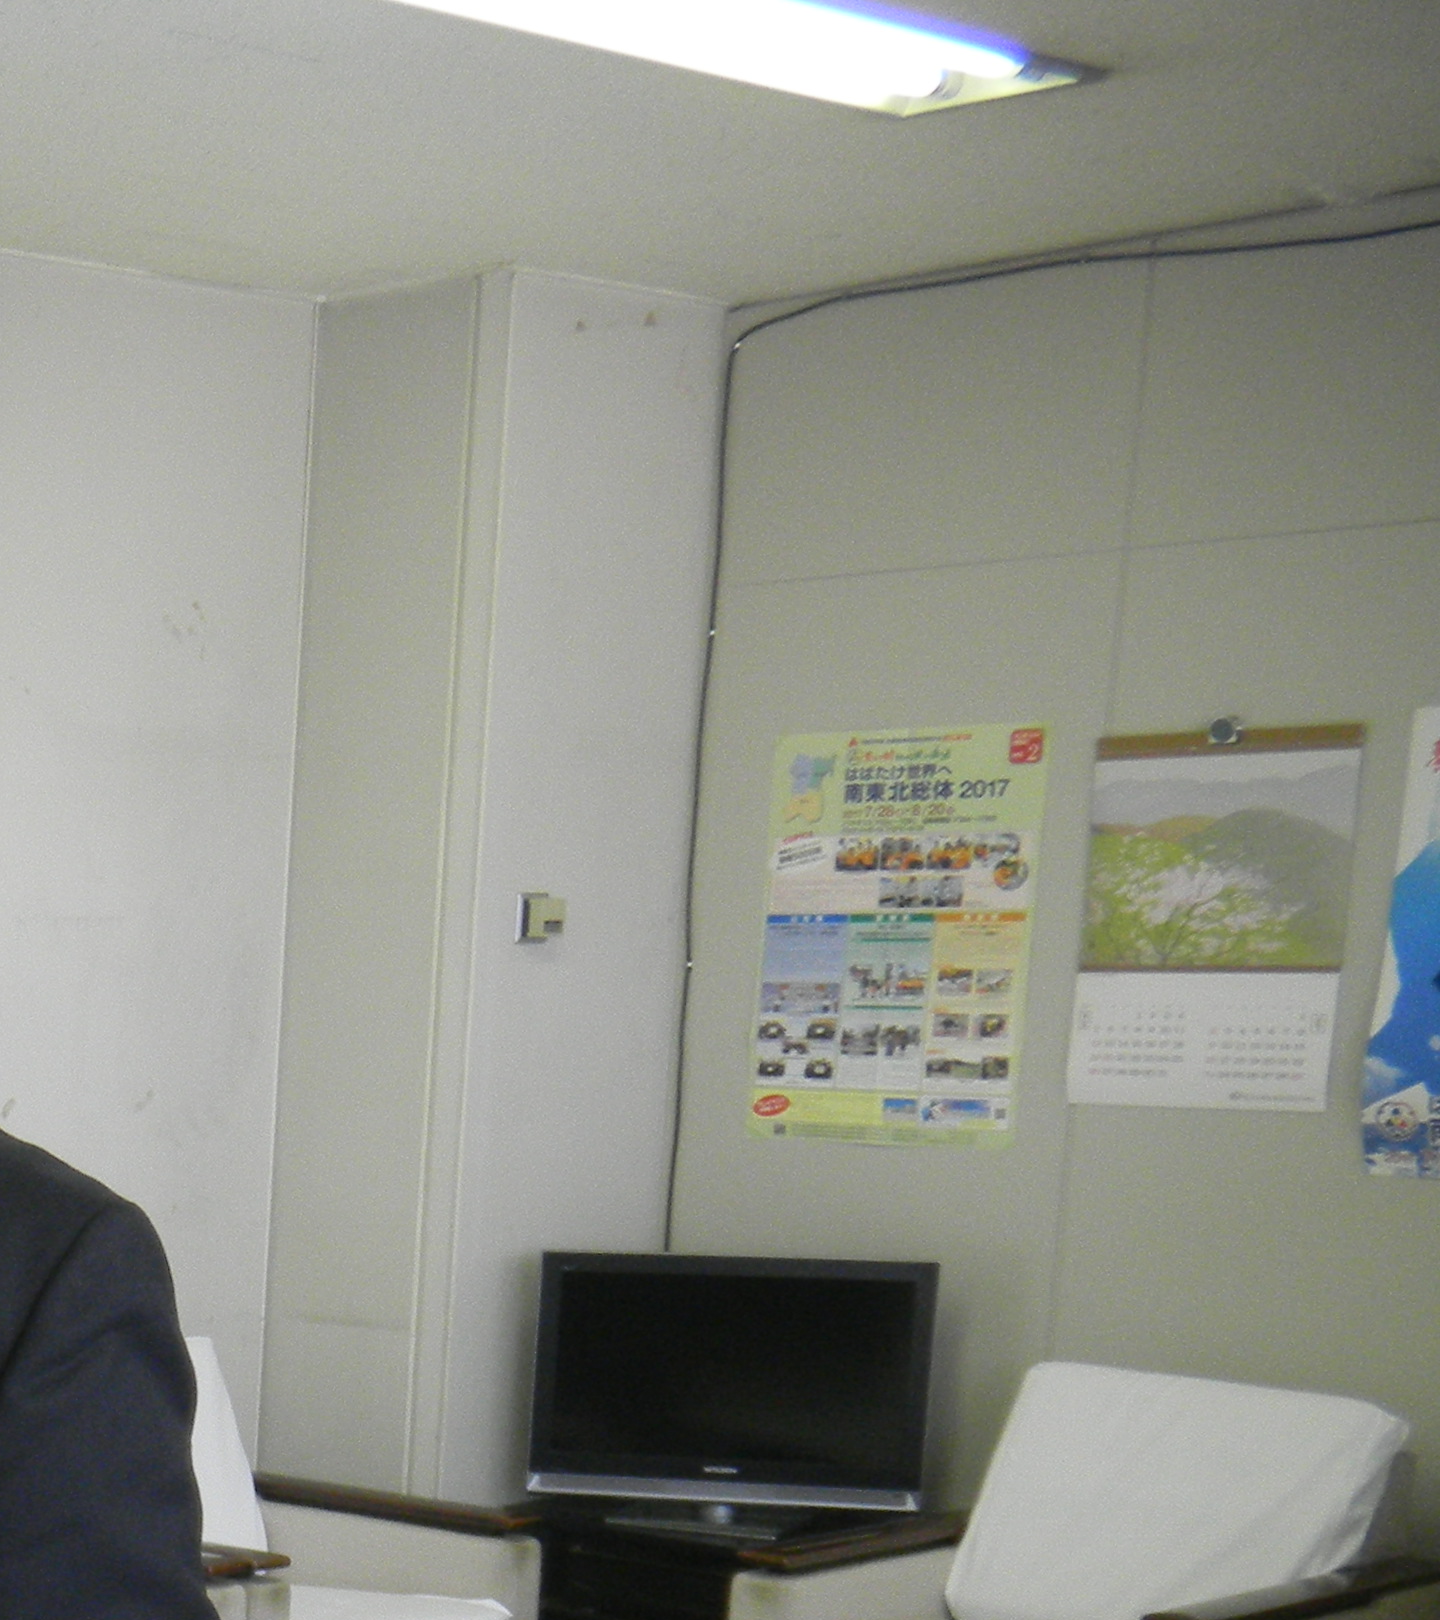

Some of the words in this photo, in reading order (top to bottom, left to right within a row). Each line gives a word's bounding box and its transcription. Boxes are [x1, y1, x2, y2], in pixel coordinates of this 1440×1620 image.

[844, 778, 955, 803] 南東北総体
[959, 778, 1011, 799] 2017
